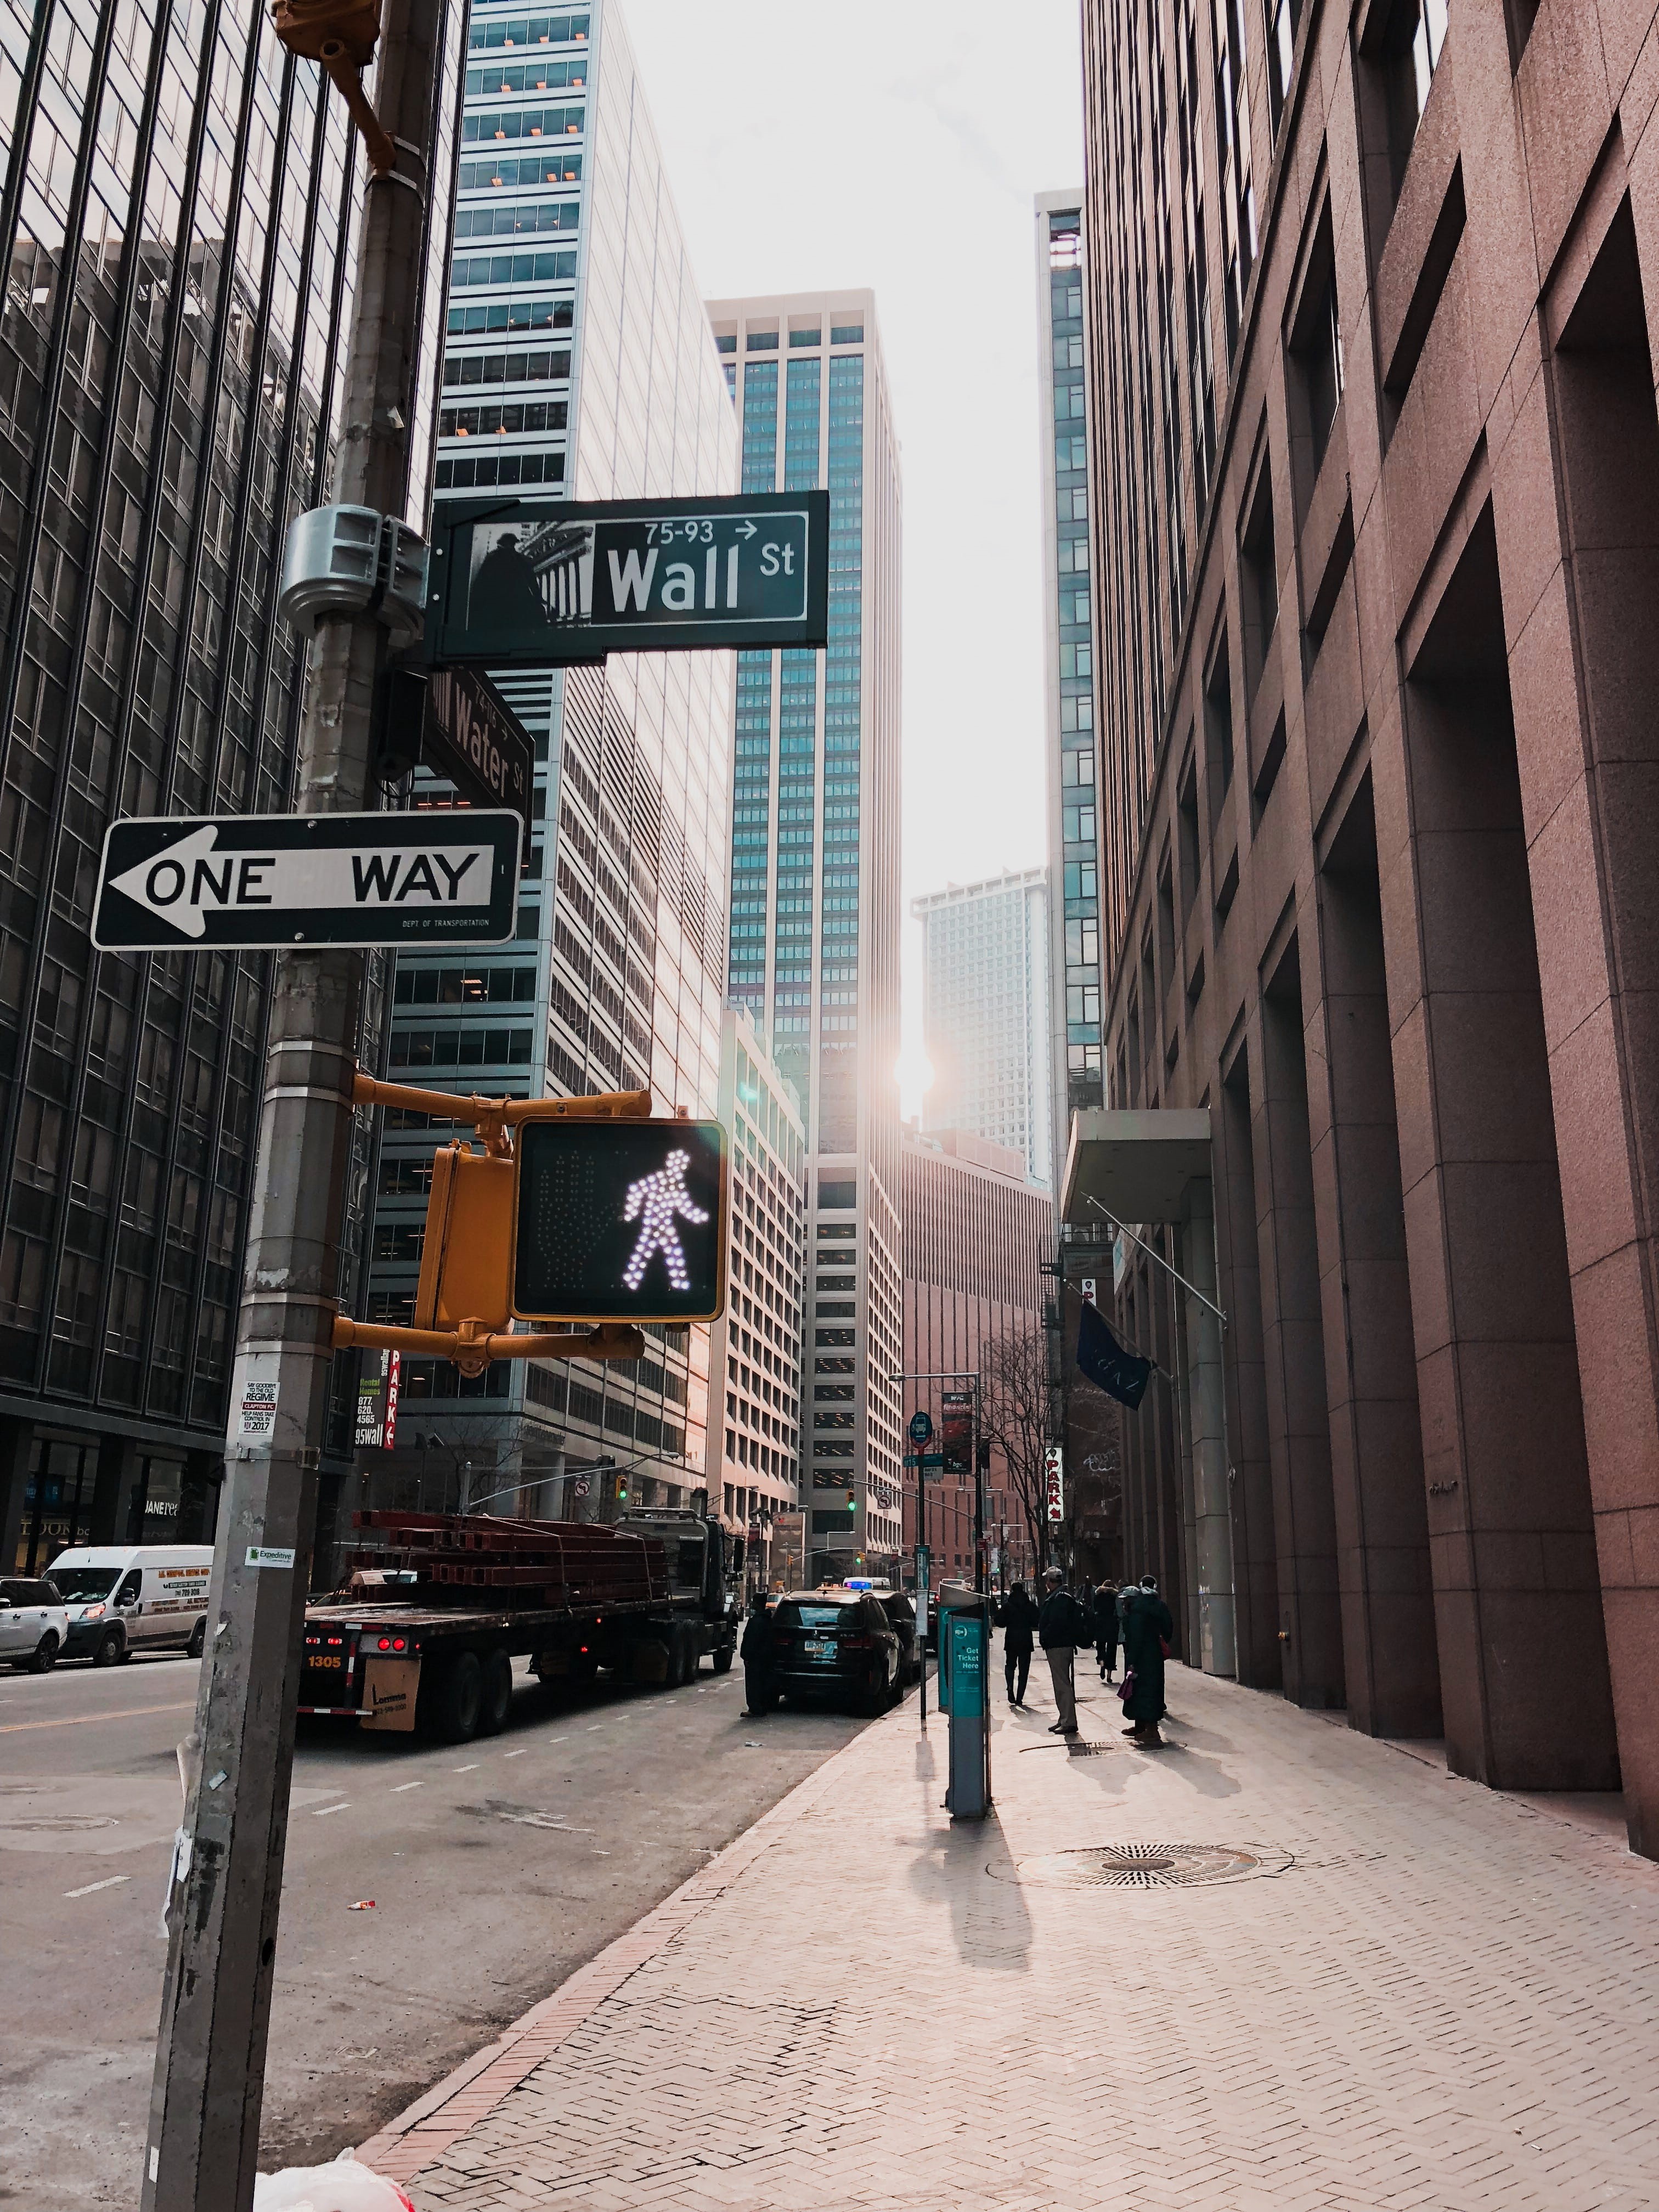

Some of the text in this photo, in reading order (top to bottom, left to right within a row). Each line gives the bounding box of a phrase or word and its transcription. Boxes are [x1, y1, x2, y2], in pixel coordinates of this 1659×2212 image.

[645, 520, 714, 545] 75-93
[608, 542, 794, 612] Wall St
[456, 682, 523, 798] Water St
[145, 854, 480, 906] ONE WAY
[360, 1378, 380, 1387] Rental
[387, 1350, 400, 1424] PARK
[246, 1393, 275, 1402] REGIME
[358, 1396, 373, 1406] 877.
[357, 1406, 373, 1415] 620.
[357, 1414, 375, 1424] 4565
[251, 1422, 270, 1430] 2017
[1047, 1459, 1062, 1506] PARK
[259, 1550, 292, 1560] Expeditive
[308, 1656, 341, 1668] 1305
